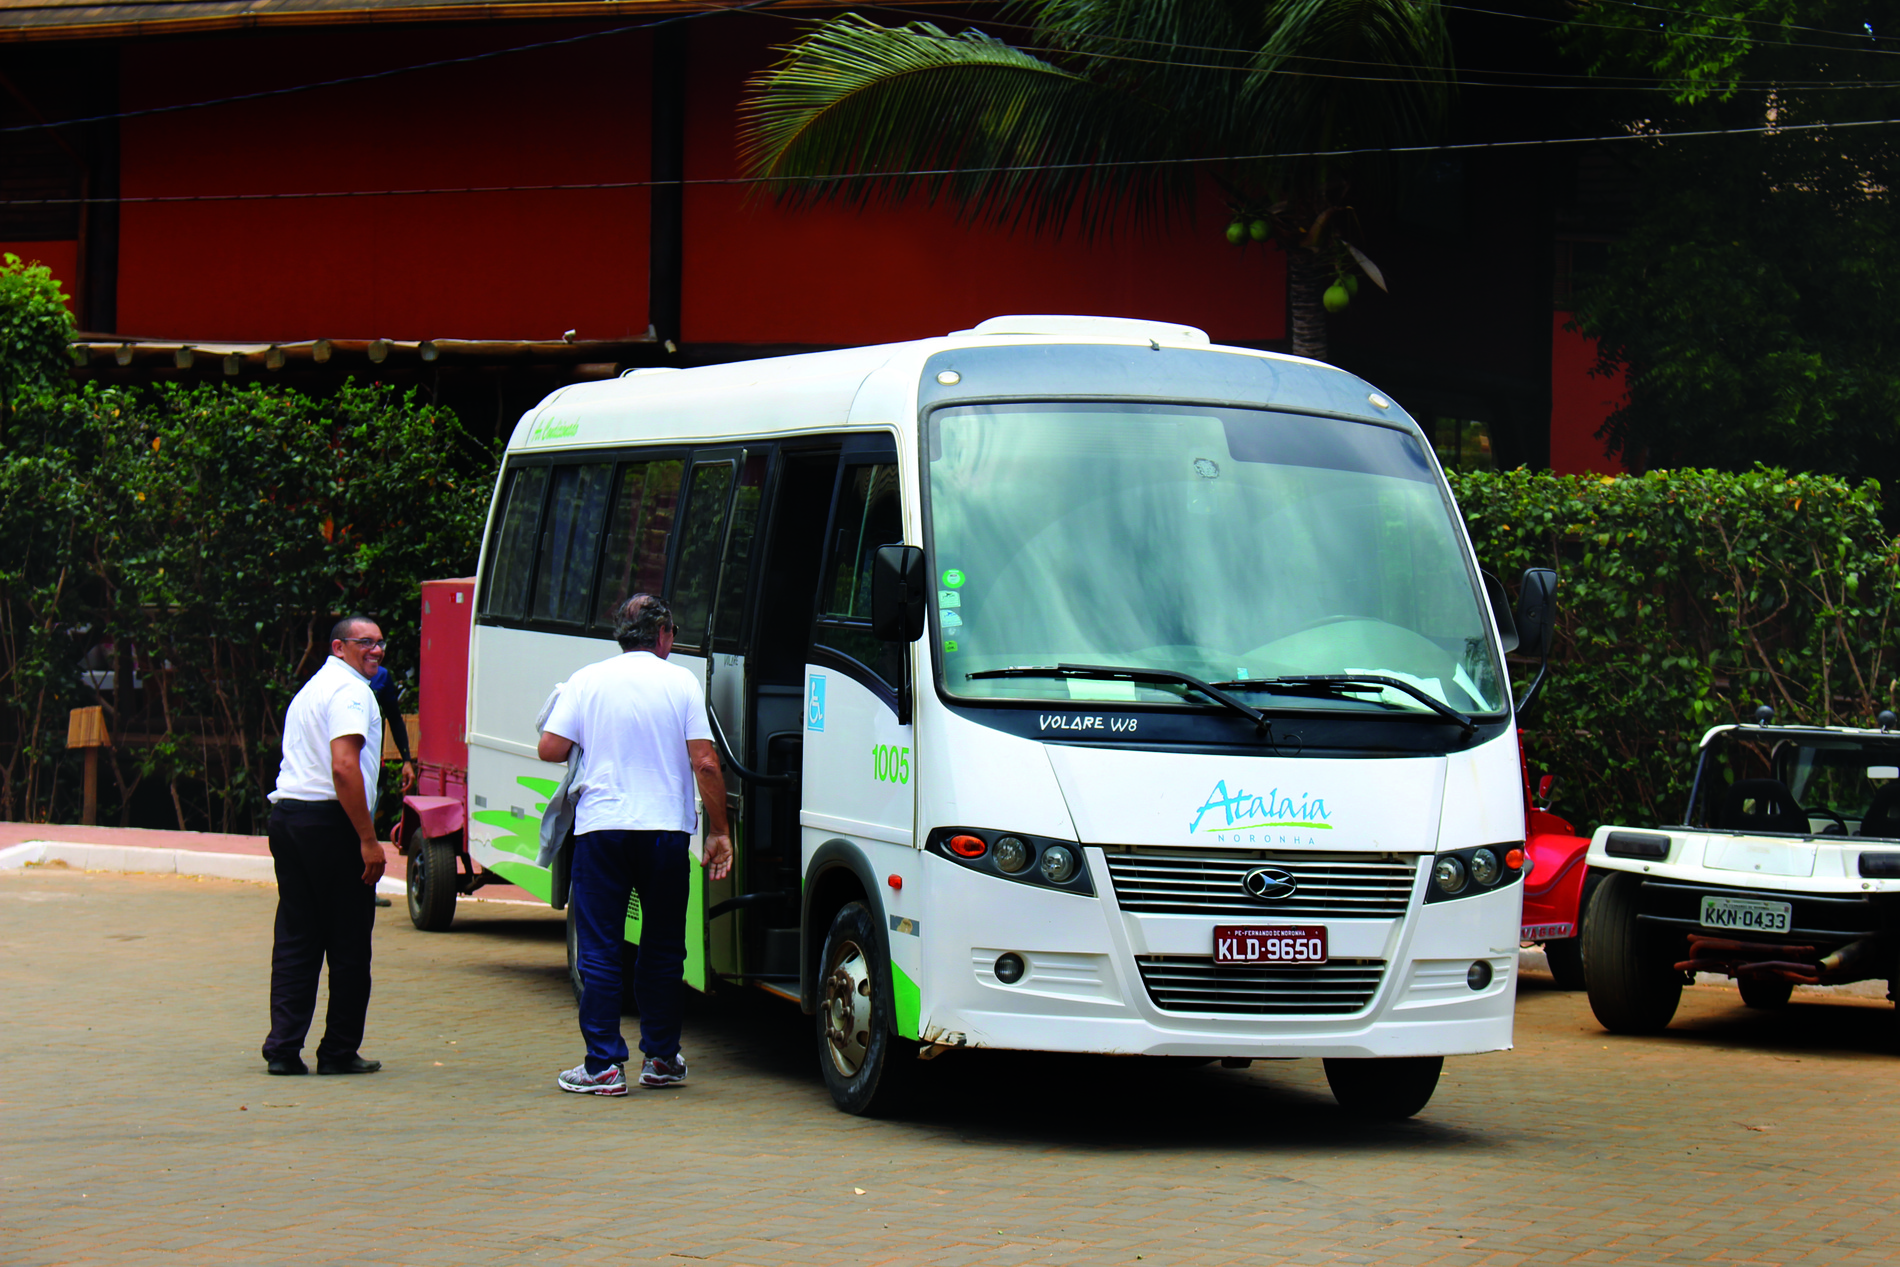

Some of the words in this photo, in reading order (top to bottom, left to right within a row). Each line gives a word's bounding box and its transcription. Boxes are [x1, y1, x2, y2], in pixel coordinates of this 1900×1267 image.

[1039, 714, 1105, 731] VOLARE
[1110, 717, 1138, 733] W8
[872, 744, 910, 785] 1005
[1189, 779, 1332, 834] Atalaia
[1217, 834, 1315, 845] NORONHA
